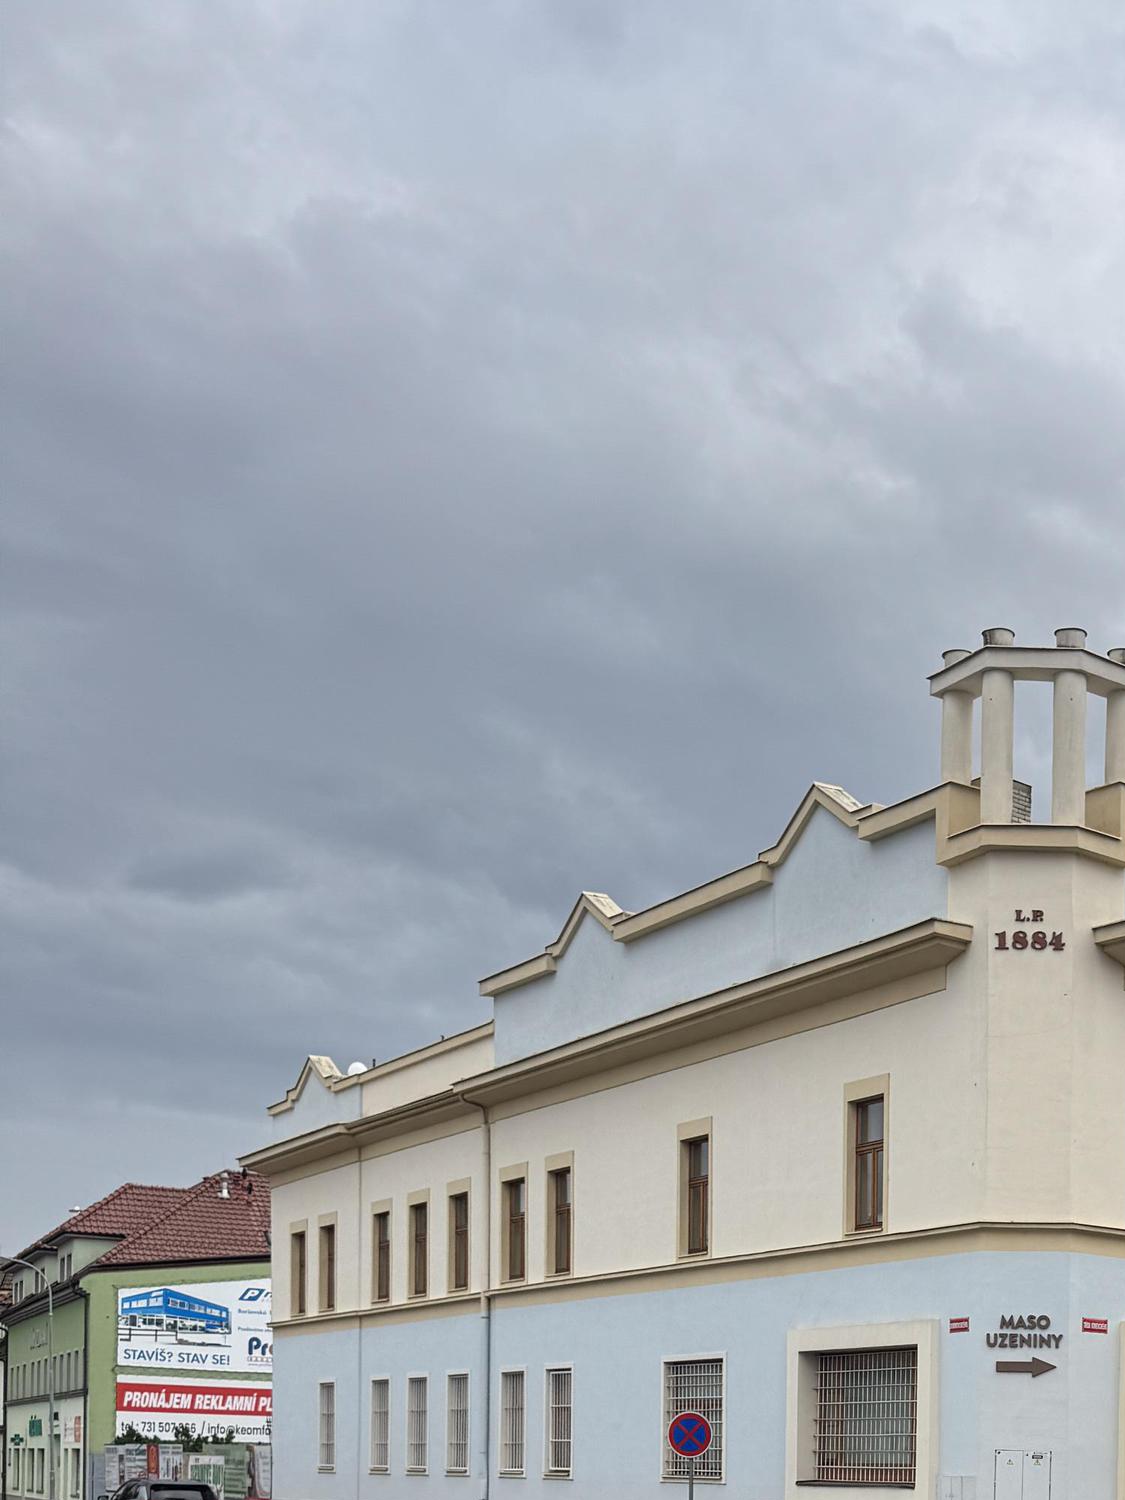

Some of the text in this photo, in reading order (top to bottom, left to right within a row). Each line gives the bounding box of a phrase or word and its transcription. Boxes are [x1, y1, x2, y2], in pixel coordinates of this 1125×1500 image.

[994, 930, 1066, 951] 1884
[999, 1314, 1051, 1330] MASO
[986, 1333, 1064, 1349] UZENINY
[123, 1348, 230, 1366] STAVÍŠ? STAV SE!
[123, 1389, 192, 1409] PRONÁJEM
[194, 1393, 257, 1411] REKLAMNÍ
[141, 1421, 156, 1432] 731
[158, 1421, 176, 1433] 507
